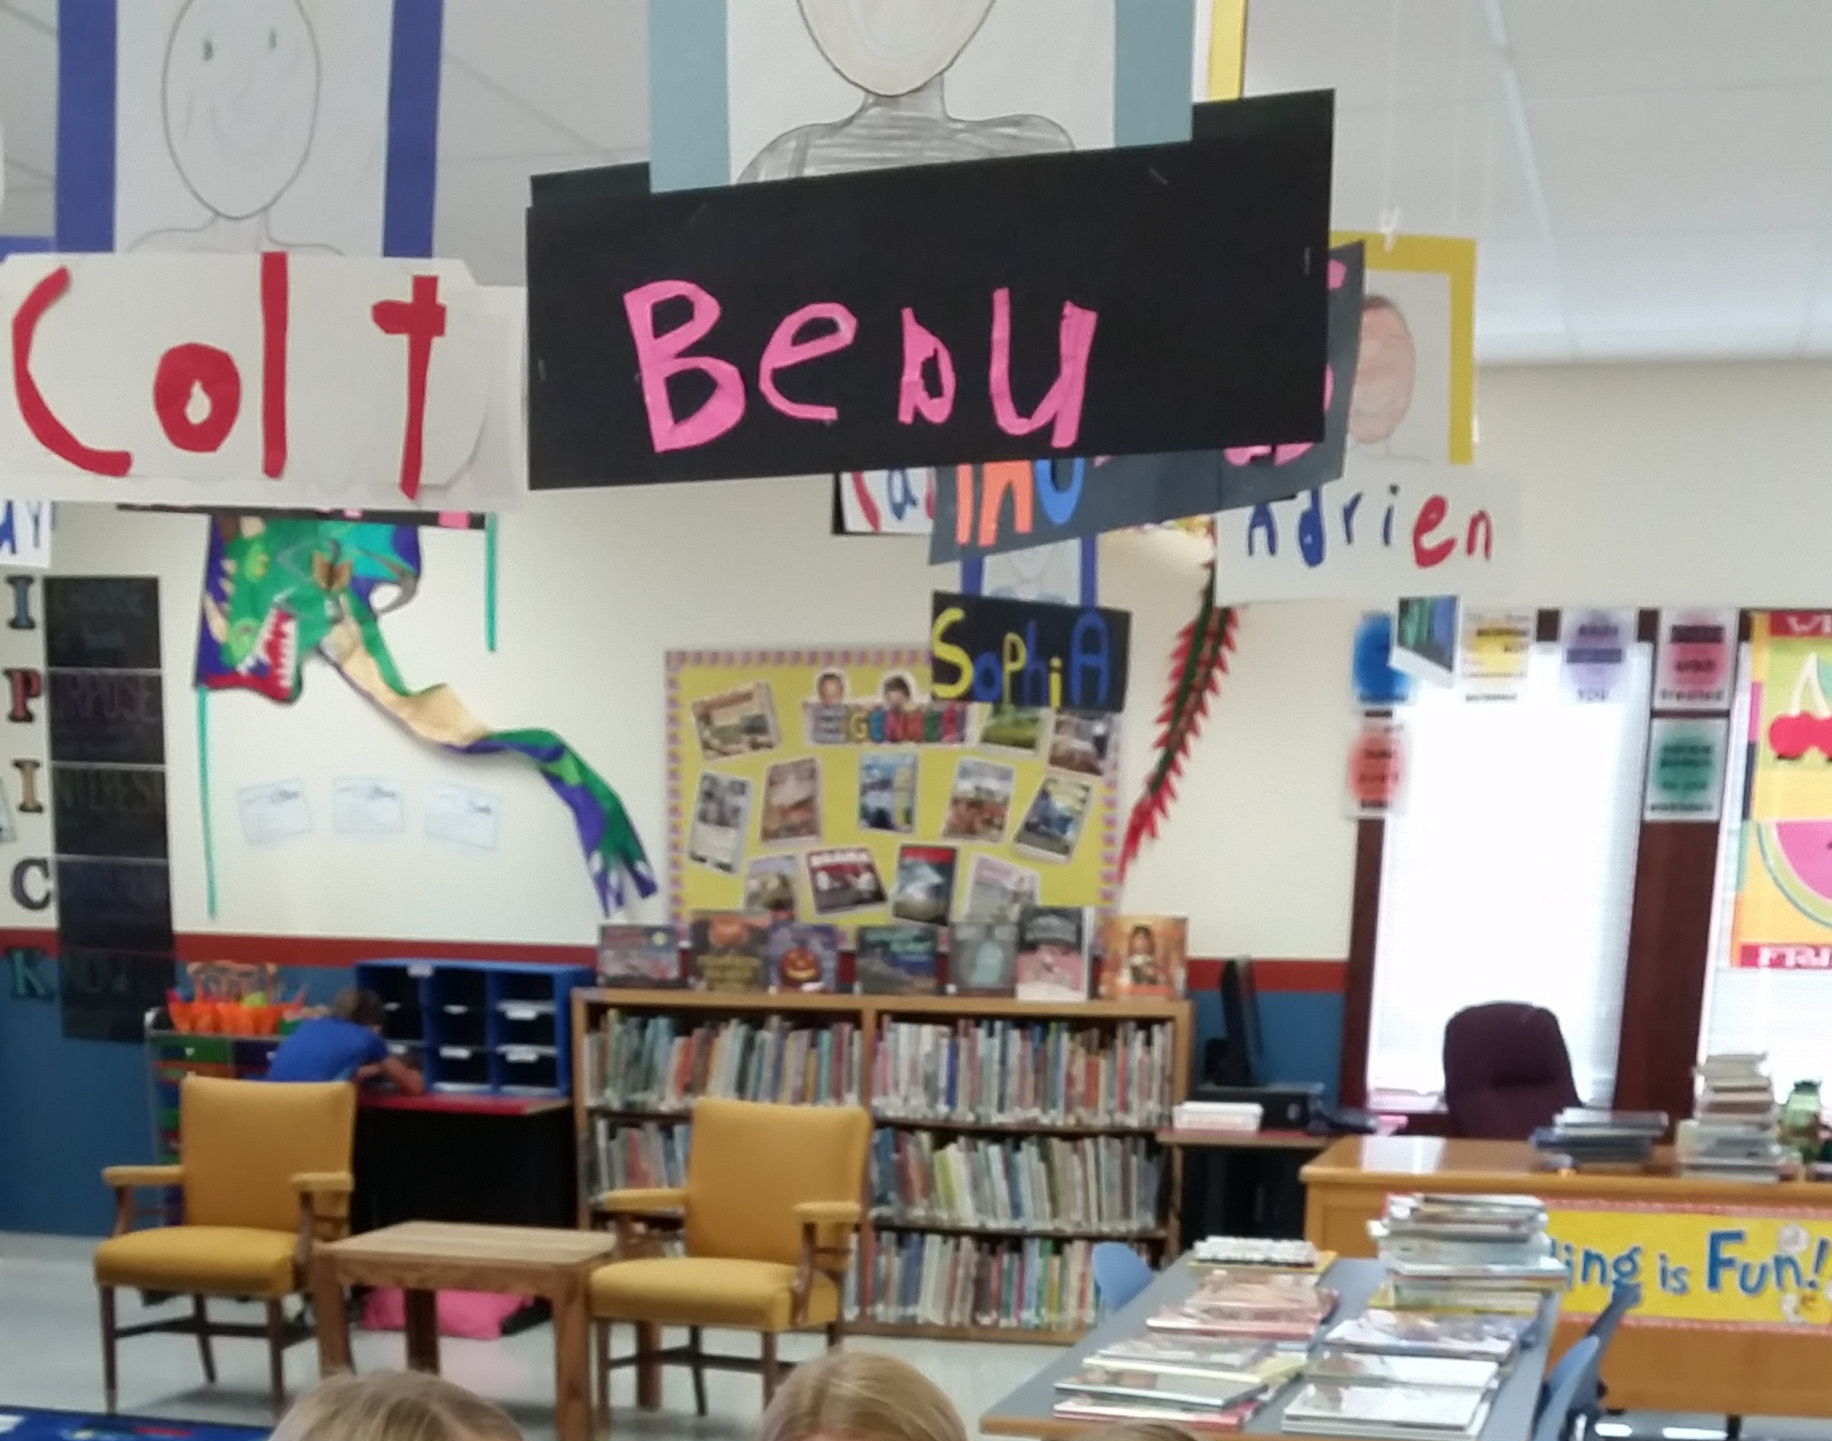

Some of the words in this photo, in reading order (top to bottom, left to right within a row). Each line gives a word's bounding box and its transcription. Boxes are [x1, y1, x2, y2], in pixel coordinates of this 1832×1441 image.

[11, 252, 447, 500] Colt
[1551, 1239, 1642, 1290] ing
[1658, 1252, 1690, 1295] is
[1706, 1228, 1832, 1296] Fun!
